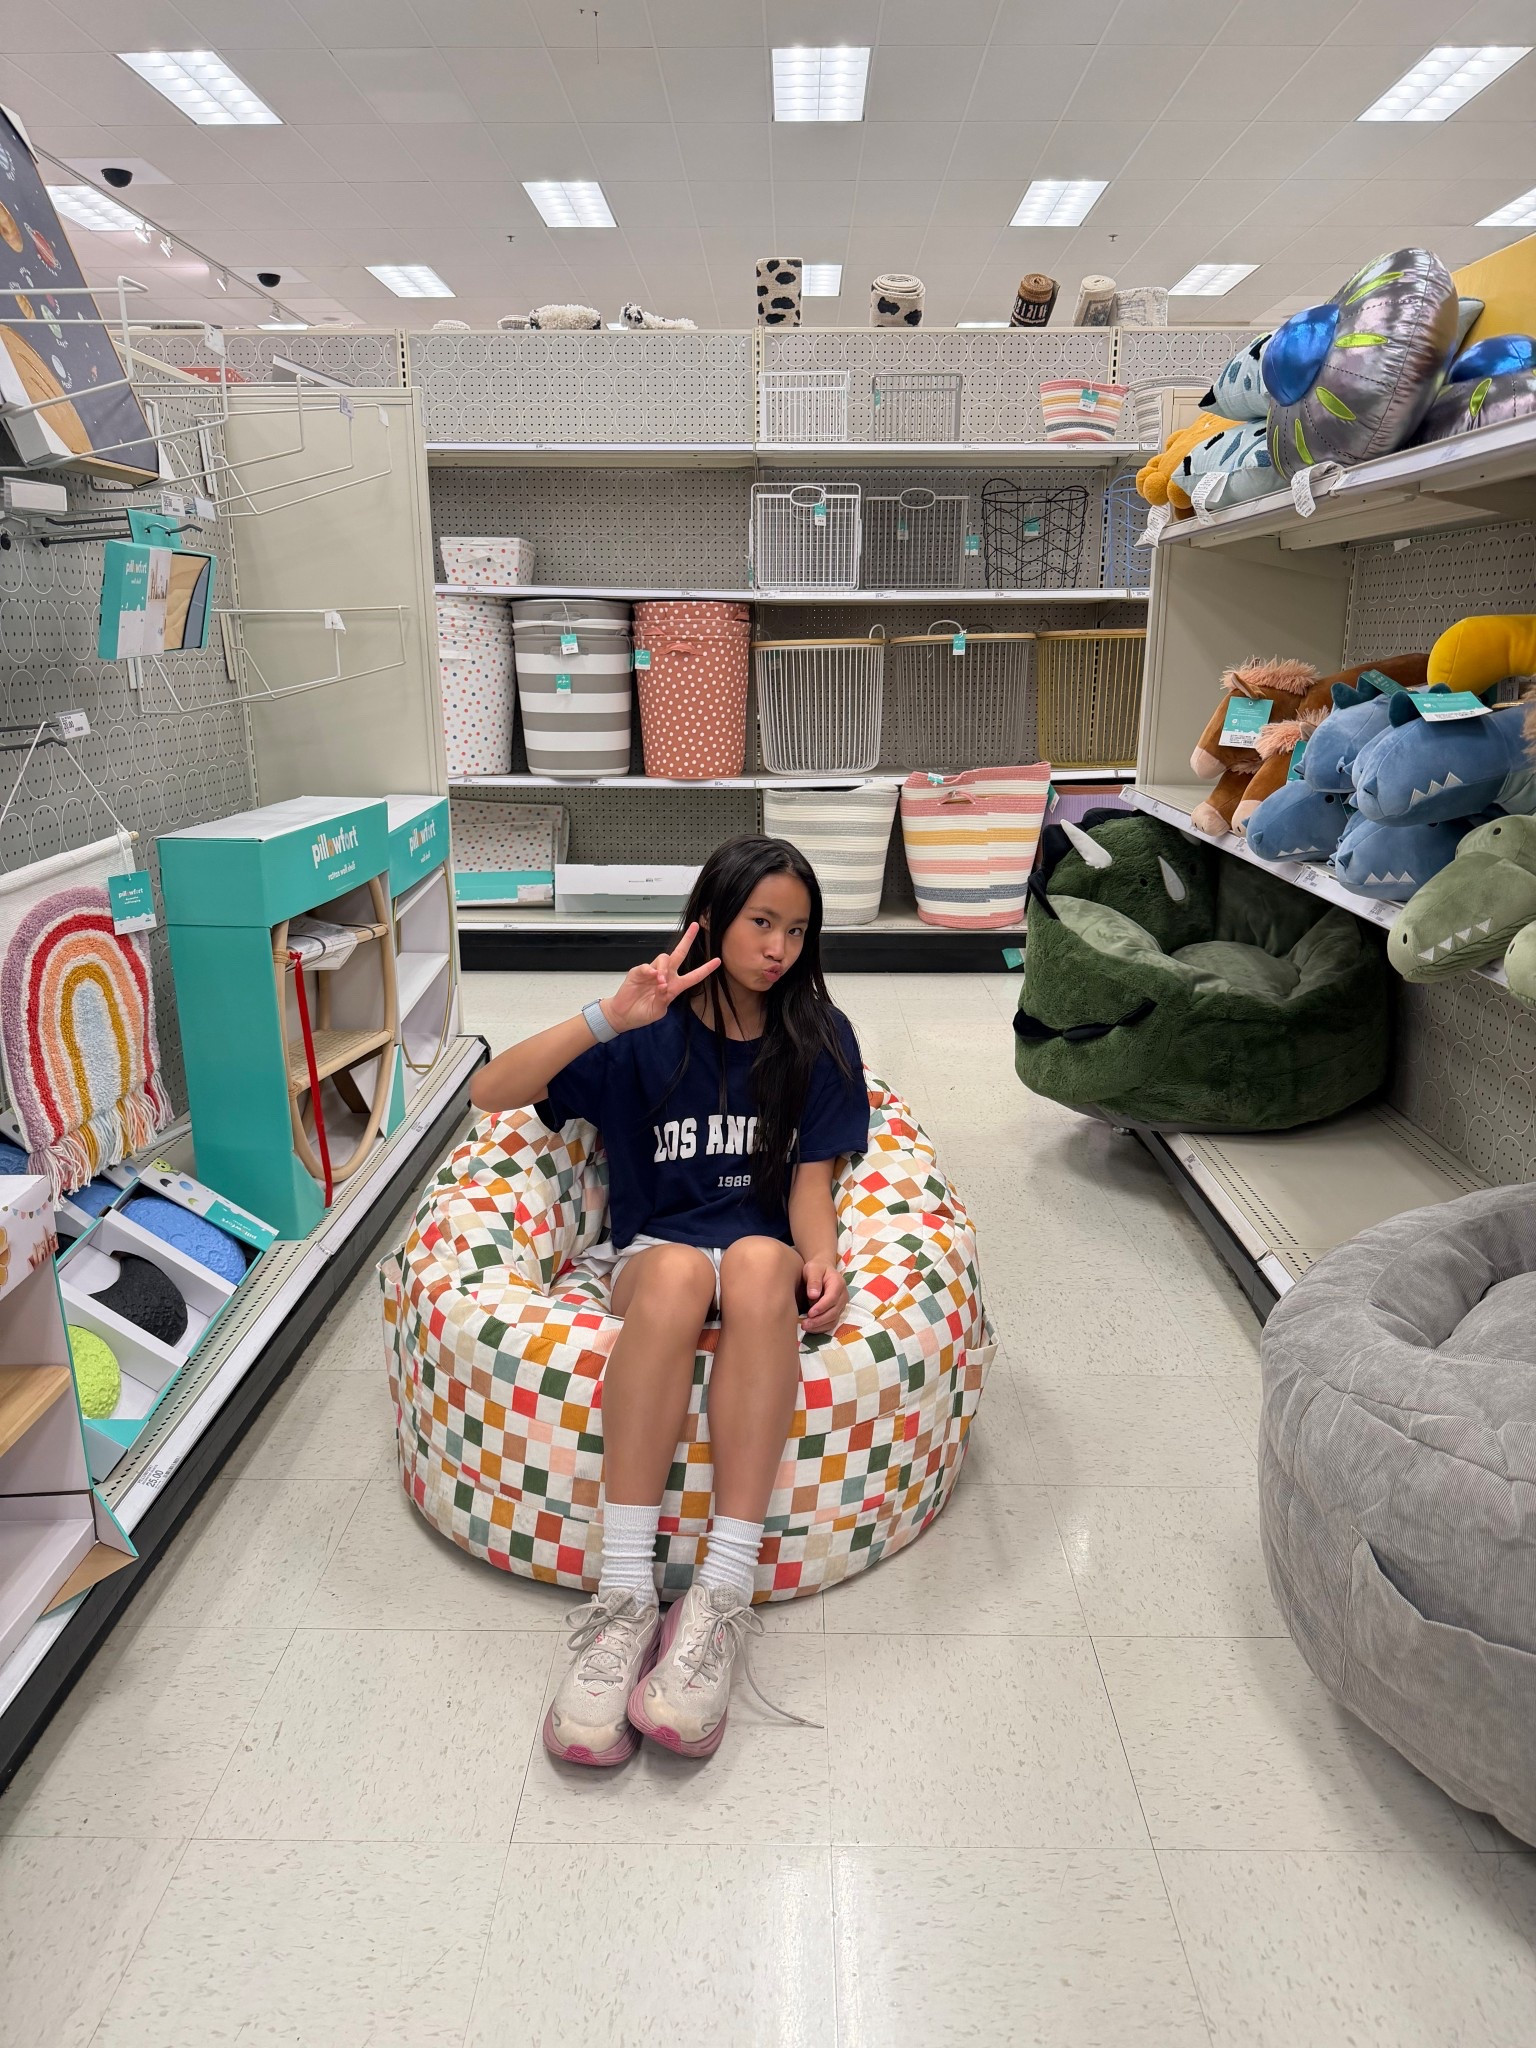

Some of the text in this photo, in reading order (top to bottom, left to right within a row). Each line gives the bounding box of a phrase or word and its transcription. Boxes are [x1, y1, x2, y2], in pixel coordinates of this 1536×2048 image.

[311, 824, 359, 869] pillowfort
[408, 819, 436, 857] pillowfort
[653, 1117, 697, 1162] LOS
[718, 1174, 751, 1187] 1989
[145, 1469, 164, 1488] 25.00
